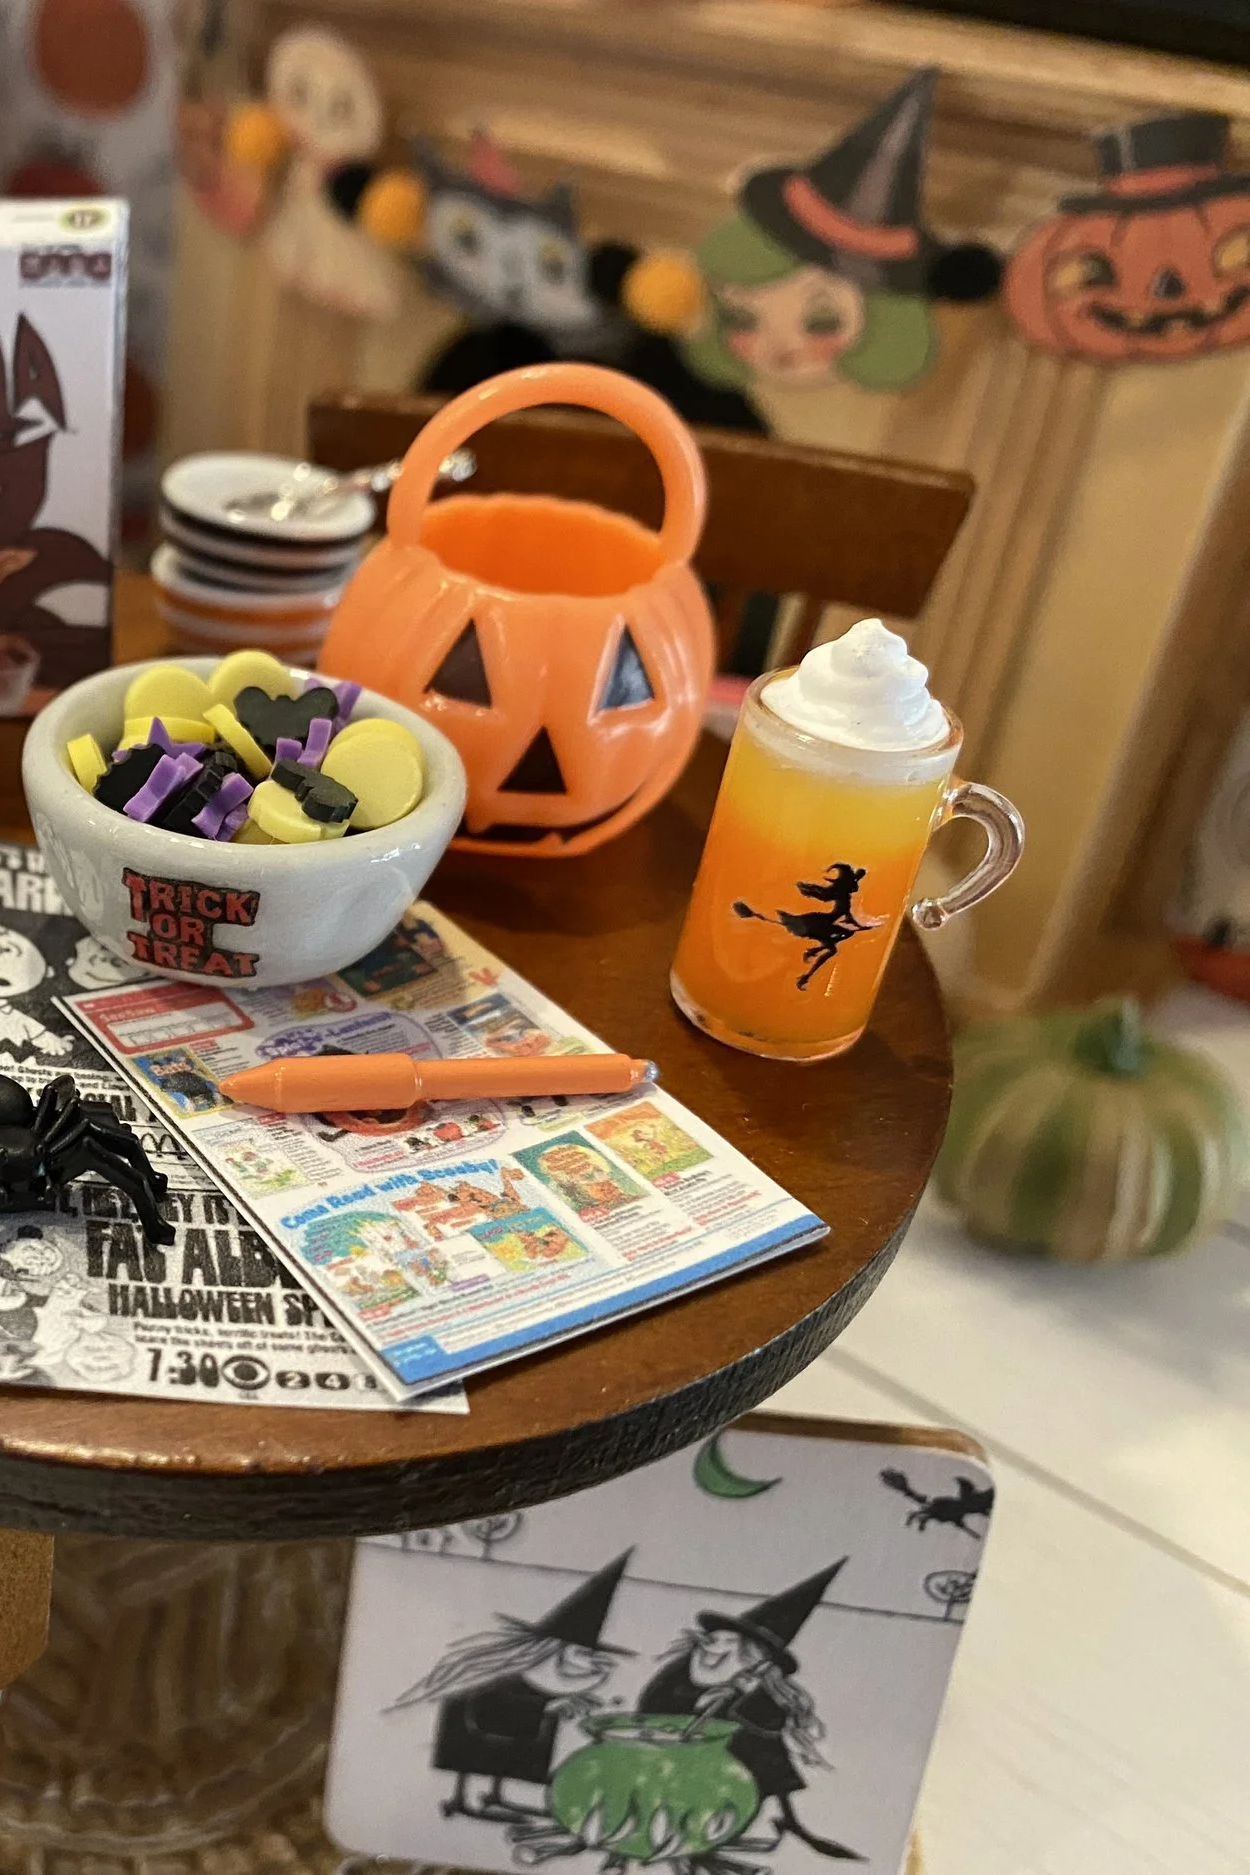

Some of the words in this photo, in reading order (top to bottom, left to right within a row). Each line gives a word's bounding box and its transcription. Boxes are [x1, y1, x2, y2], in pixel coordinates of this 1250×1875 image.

[124, 869, 256, 924] TRICK
[151, 912, 205, 946] OR
[129, 931, 258, 976] TREAT
[376, 1173, 419, 1193] with
[182, 1228, 303, 1290] ALB
[108, 1283, 276, 1326] HALLOWEEN
[147, 1348, 220, 1388] 7:30
